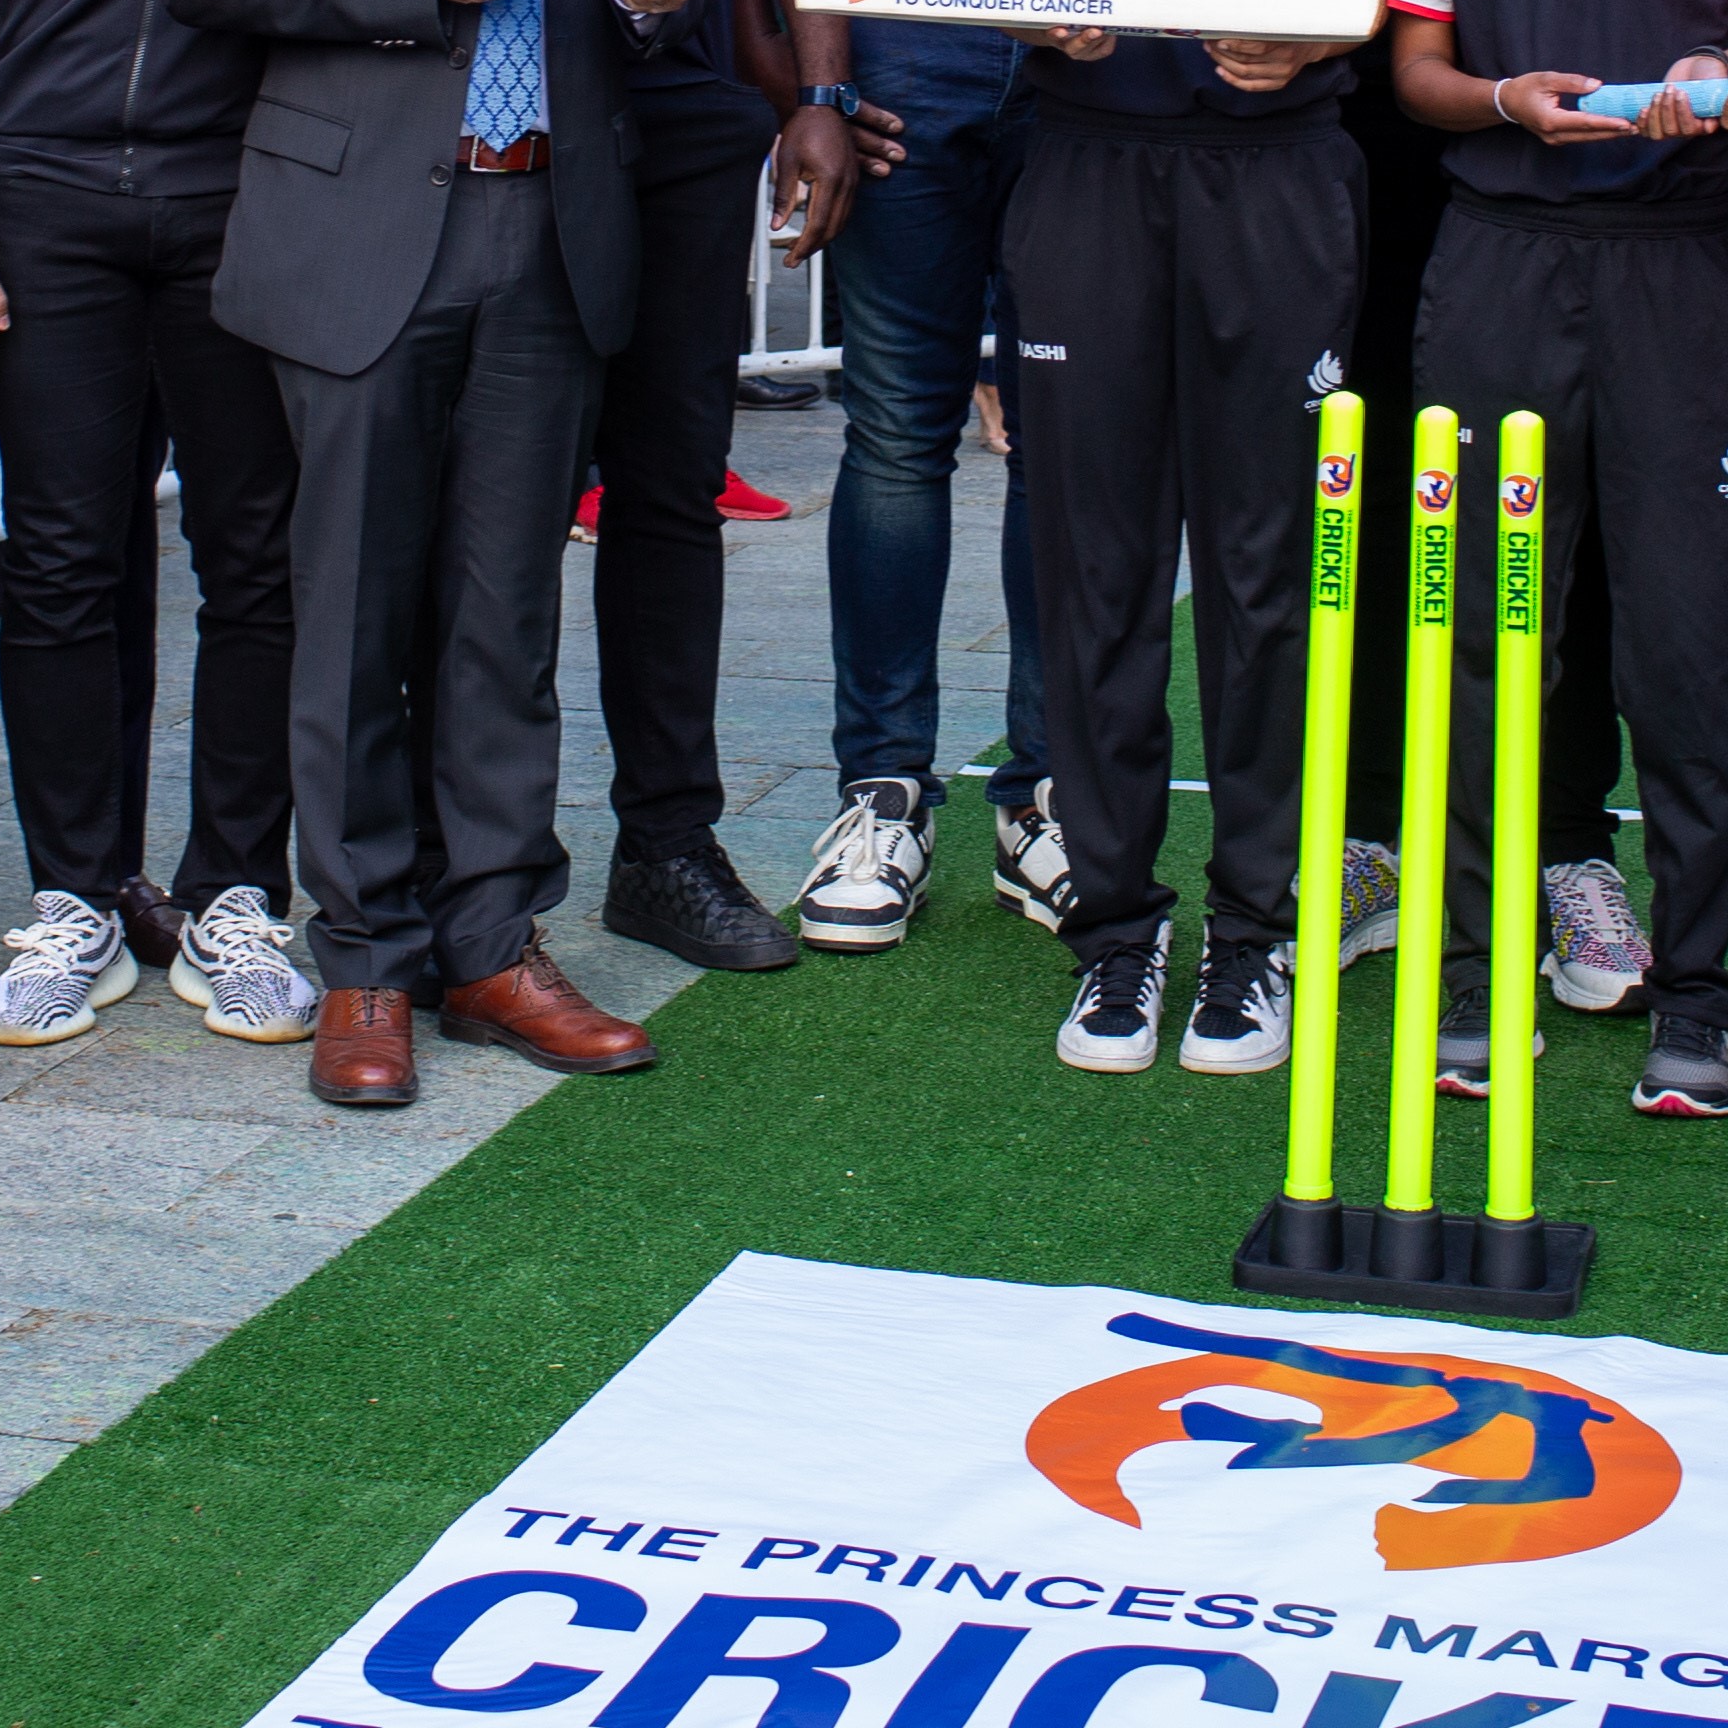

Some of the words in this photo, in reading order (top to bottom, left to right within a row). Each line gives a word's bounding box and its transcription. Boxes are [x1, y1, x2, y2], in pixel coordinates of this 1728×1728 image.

[1319, 508, 1344, 612] CRICKET
[1424, 524, 1448, 627] CRICKET
[1506, 531, 1531, 635] CRICKET
[502, 1506, 720, 1562] THE
[741, 1536, 1338, 1640] PRINCESS
